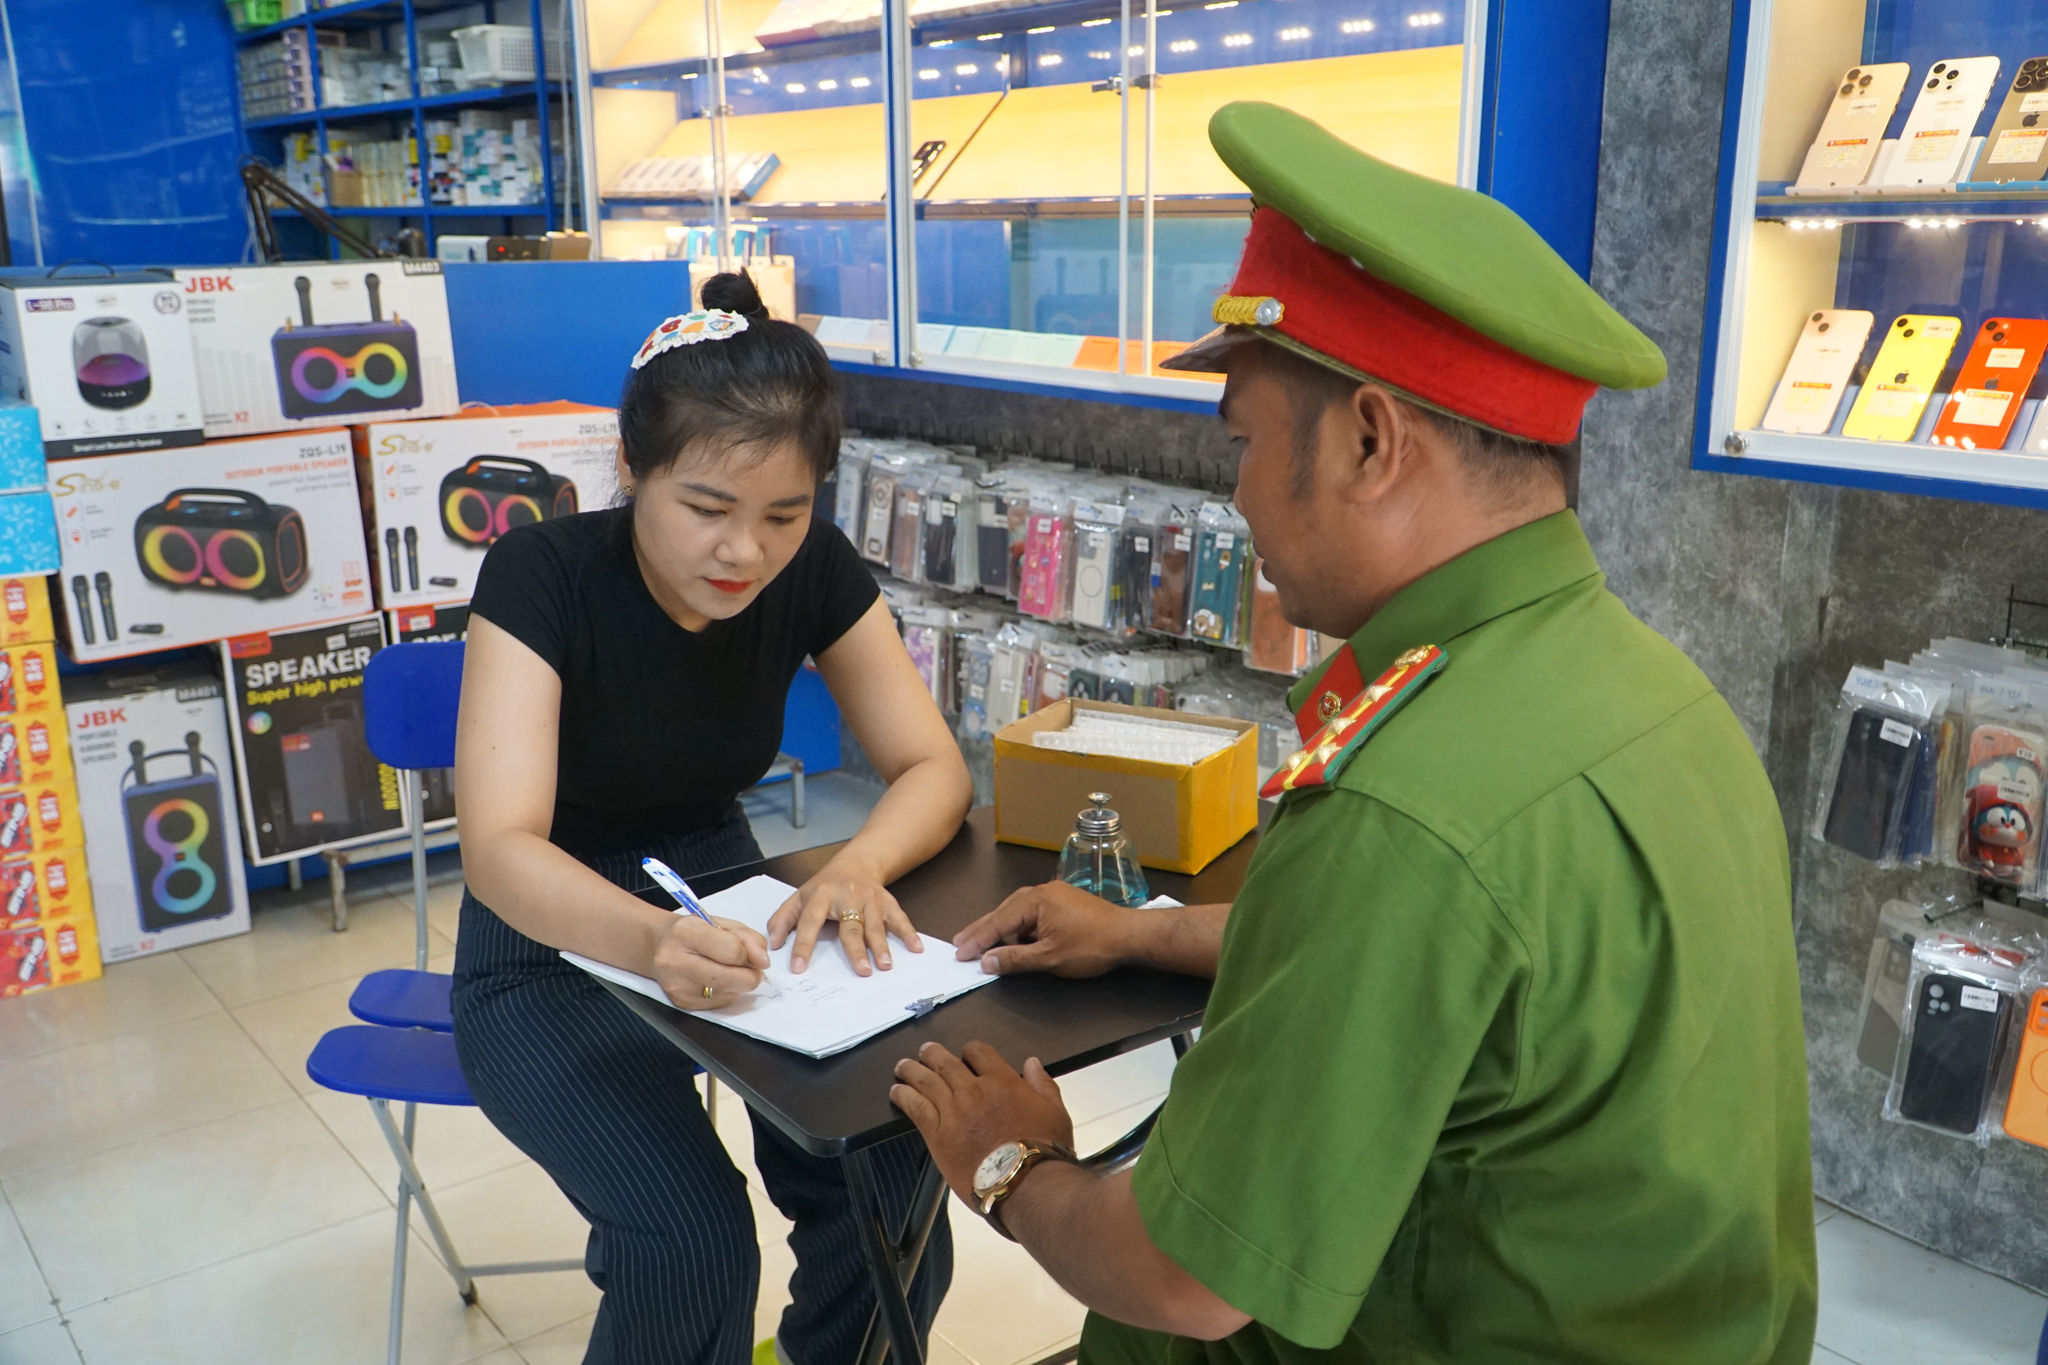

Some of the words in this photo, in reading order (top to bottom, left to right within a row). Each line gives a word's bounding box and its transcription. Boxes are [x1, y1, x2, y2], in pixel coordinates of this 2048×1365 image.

[185, 276, 235, 293] JBK
[245, 646, 371, 689] SPEAKER
[246, 686, 291, 706] Super
[294, 678, 327, 698] high
[77, 707, 127, 729] JBK
